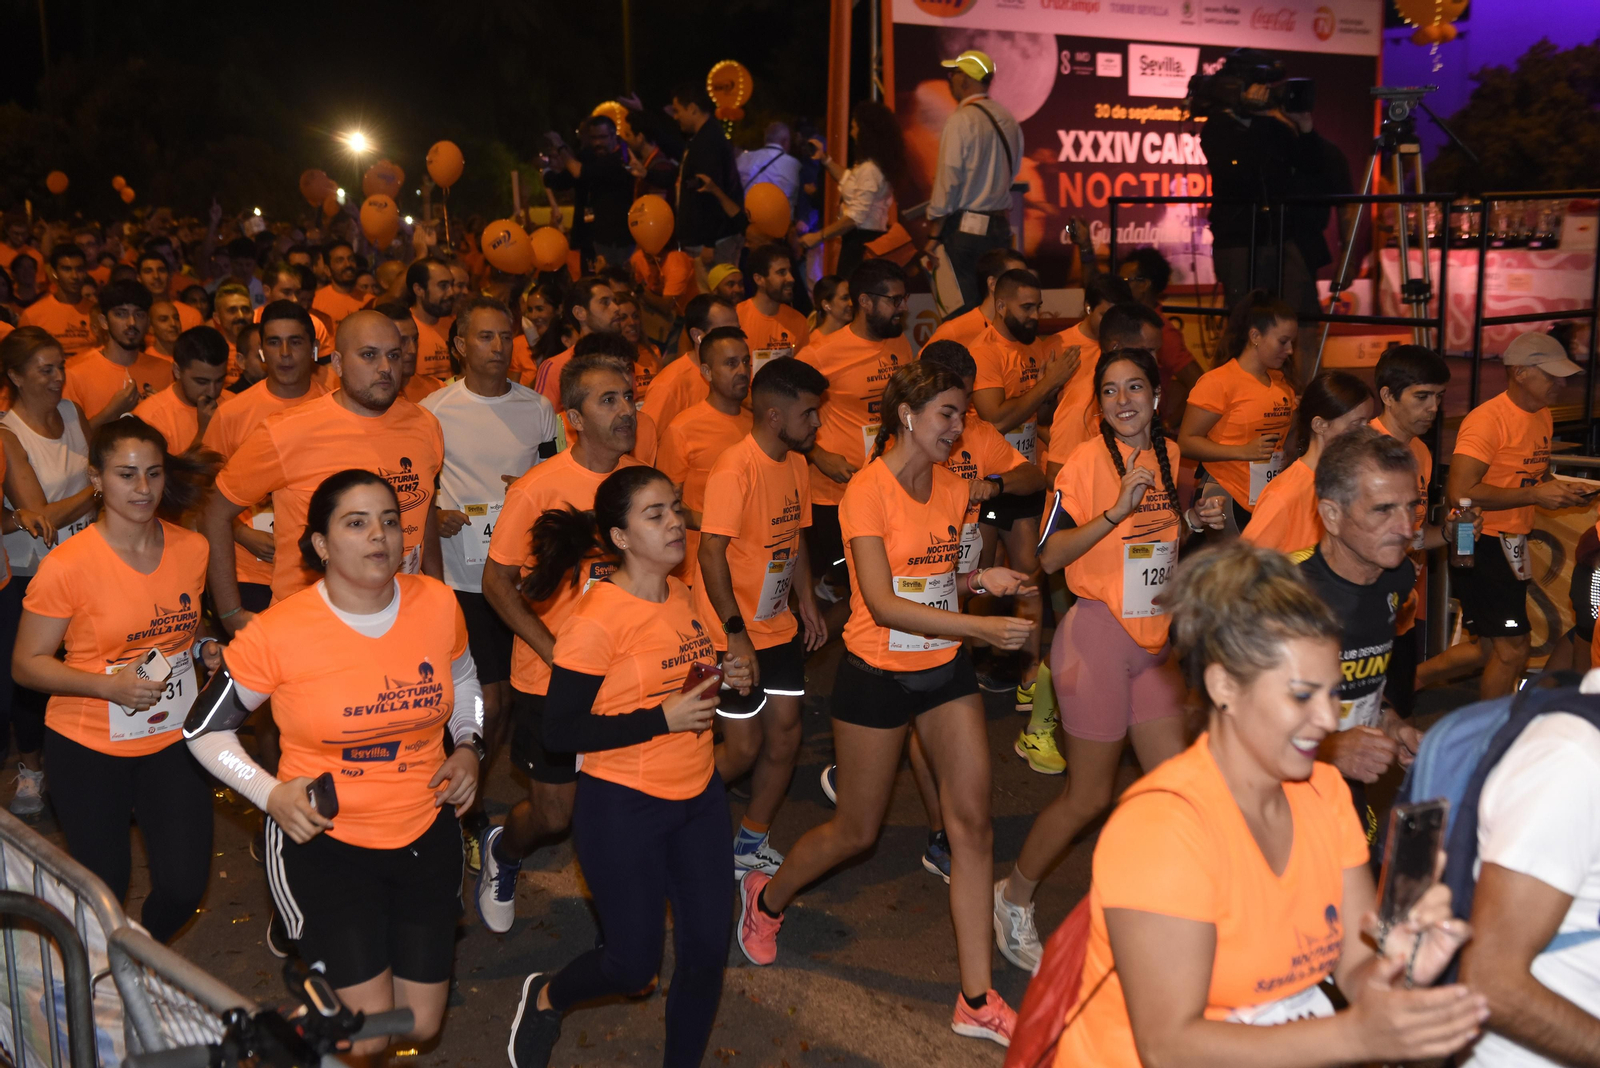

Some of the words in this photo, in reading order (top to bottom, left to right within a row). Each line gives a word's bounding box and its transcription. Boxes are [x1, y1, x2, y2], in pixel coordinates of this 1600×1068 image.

[1095, 103, 1111, 118] 30
[1111, 104, 1128, 119] de
[1128, 105, 1190, 124] septiemb
[1057, 130, 1142, 163] XXXIV
[907, 554, 944, 566] SEVILLA
[150, 610, 198, 629] NOCTURNA
[126, 625, 174, 642] SEVILLA
[678, 635, 712, 654] NOCTURNA
[661, 651, 699, 670] SEVILLA
[157, 679, 183, 702] 31
[377, 683, 443, 702] NOCTURNA
[342, 700, 409, 717] SEVILLA
